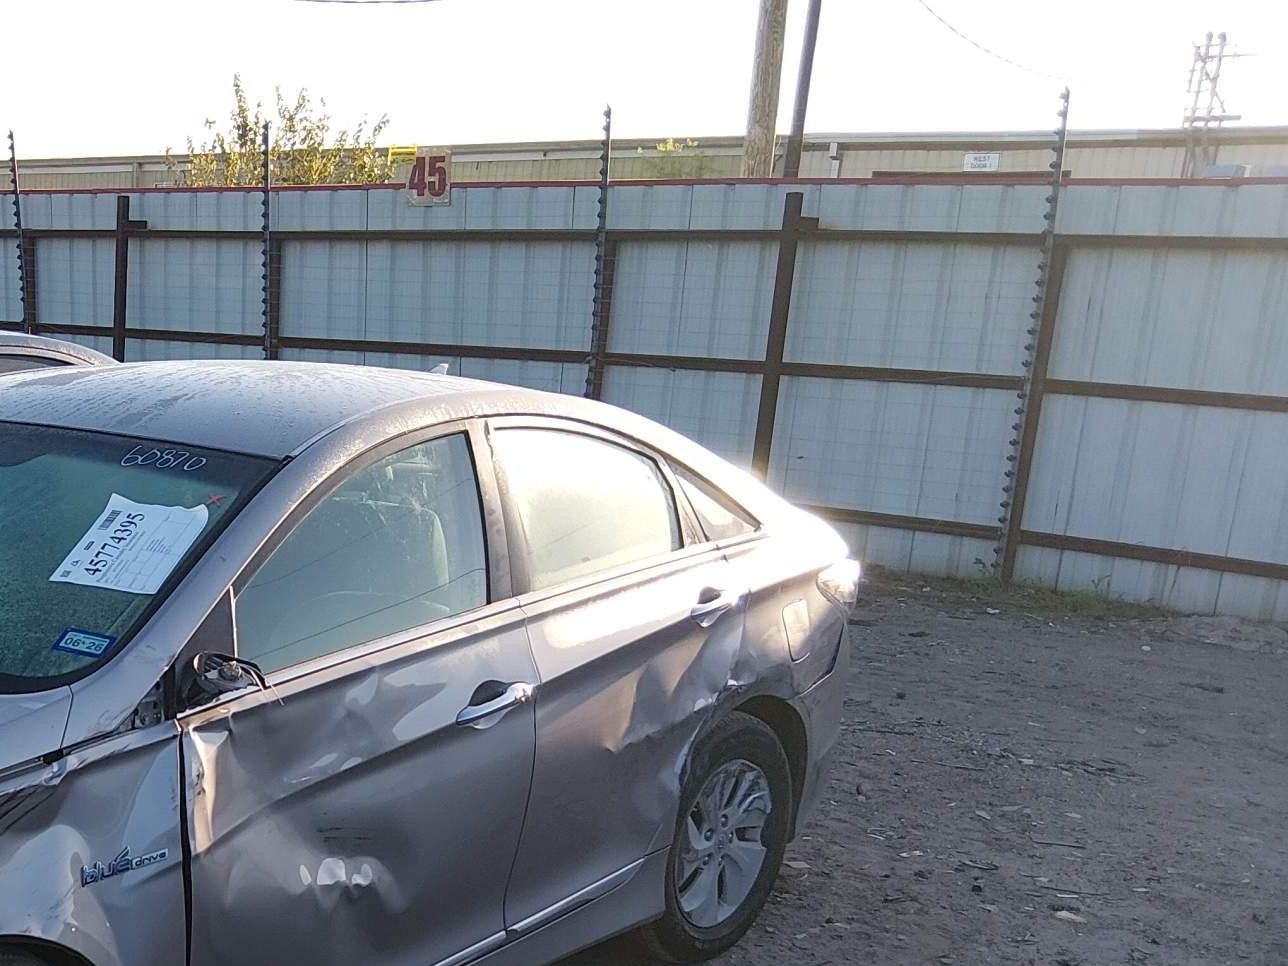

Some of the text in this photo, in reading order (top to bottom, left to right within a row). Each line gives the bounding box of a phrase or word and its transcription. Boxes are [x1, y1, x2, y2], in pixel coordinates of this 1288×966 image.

[408, 156, 447, 197] 45
[83, 512, 145, 577] 45774395
[64, 637, 81, 647] 06
[86, 641, 104, 652] 26
[134, 850, 167, 868] drive
